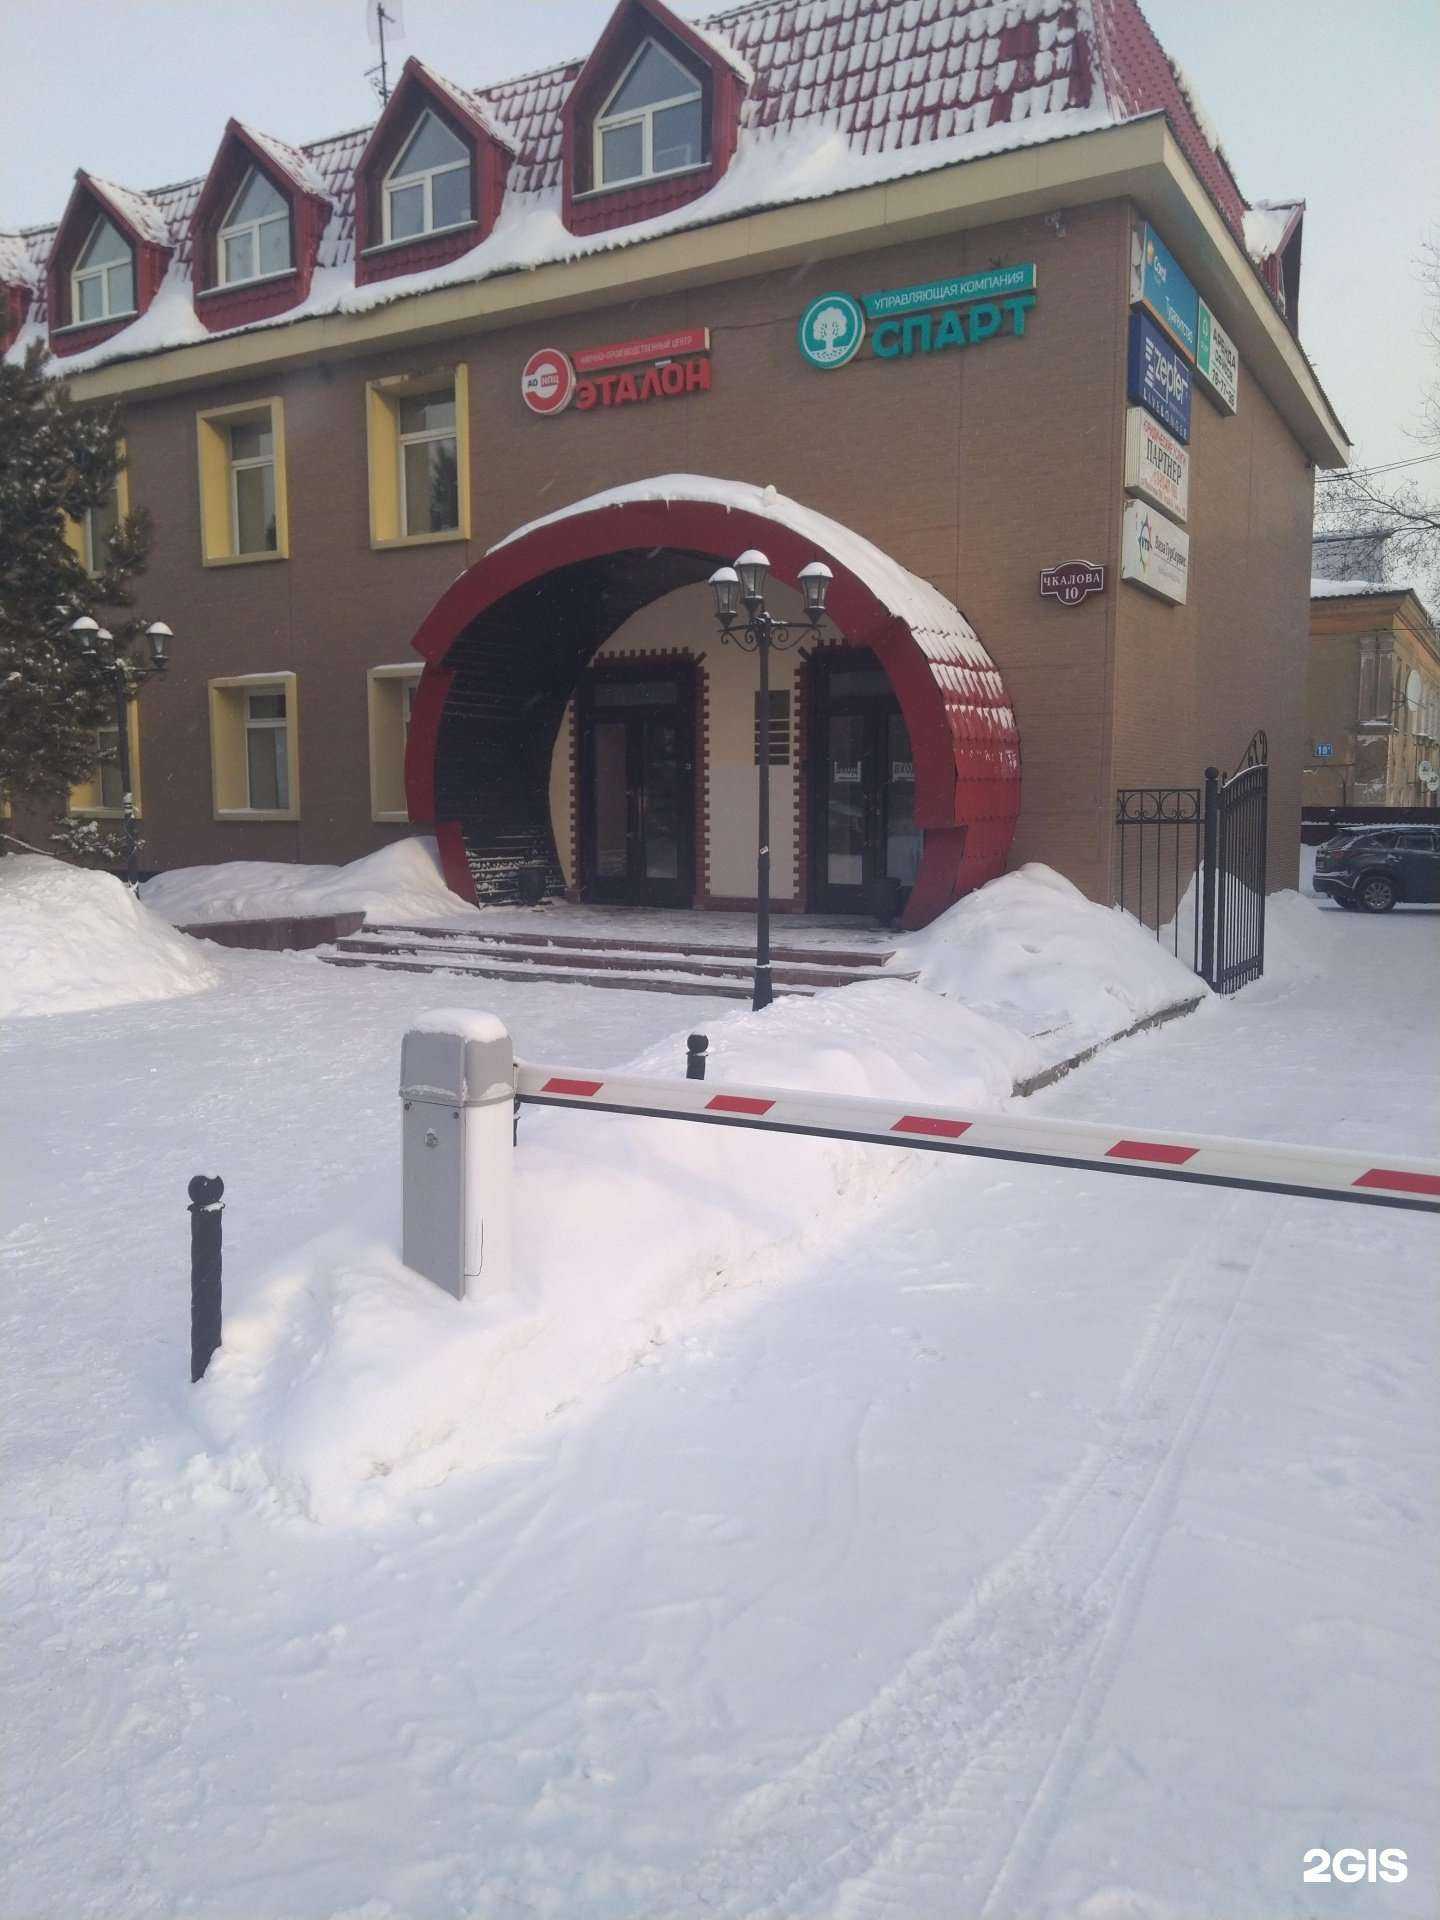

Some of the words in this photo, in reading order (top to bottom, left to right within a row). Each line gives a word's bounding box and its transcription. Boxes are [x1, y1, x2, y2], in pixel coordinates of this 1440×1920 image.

[874, 284, 958, 310] УПРАВЛЯЮЩАЯ
[960, 271, 1024, 294] КОМПАНИЯ
[871, 295, 1038, 360] СПАРТ
[575, 358, 711, 411] ЭТАЛОН
[1147, 438, 1182, 486] ПАРТНЕР
[1043, 572, 1100, 587] ЧКАЛОВА
[1065, 586, 1079, 600] 10
